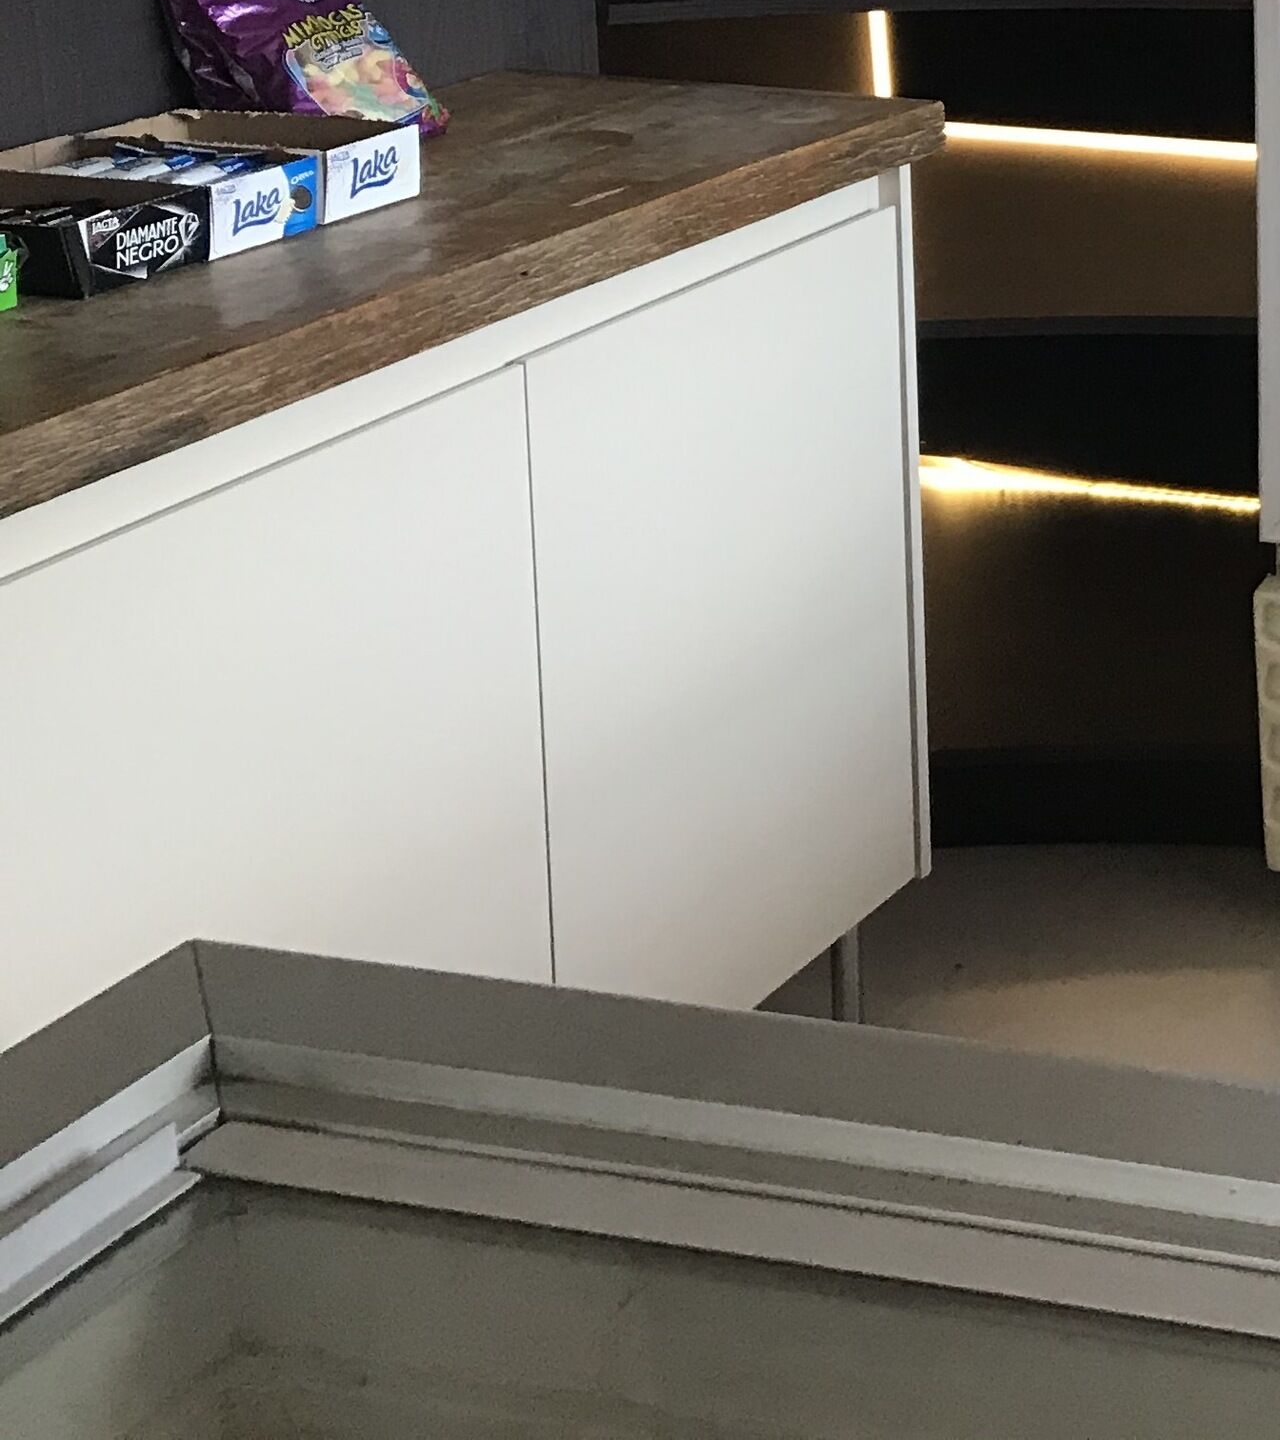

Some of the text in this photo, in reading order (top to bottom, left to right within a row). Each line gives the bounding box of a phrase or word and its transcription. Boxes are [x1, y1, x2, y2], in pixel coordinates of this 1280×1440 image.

[350, 145, 398, 199] Laka
[232, 187, 281, 237] Laka
[116, 216, 178, 251] DIAMANTE
[116, 235, 179, 269] NEGRO
